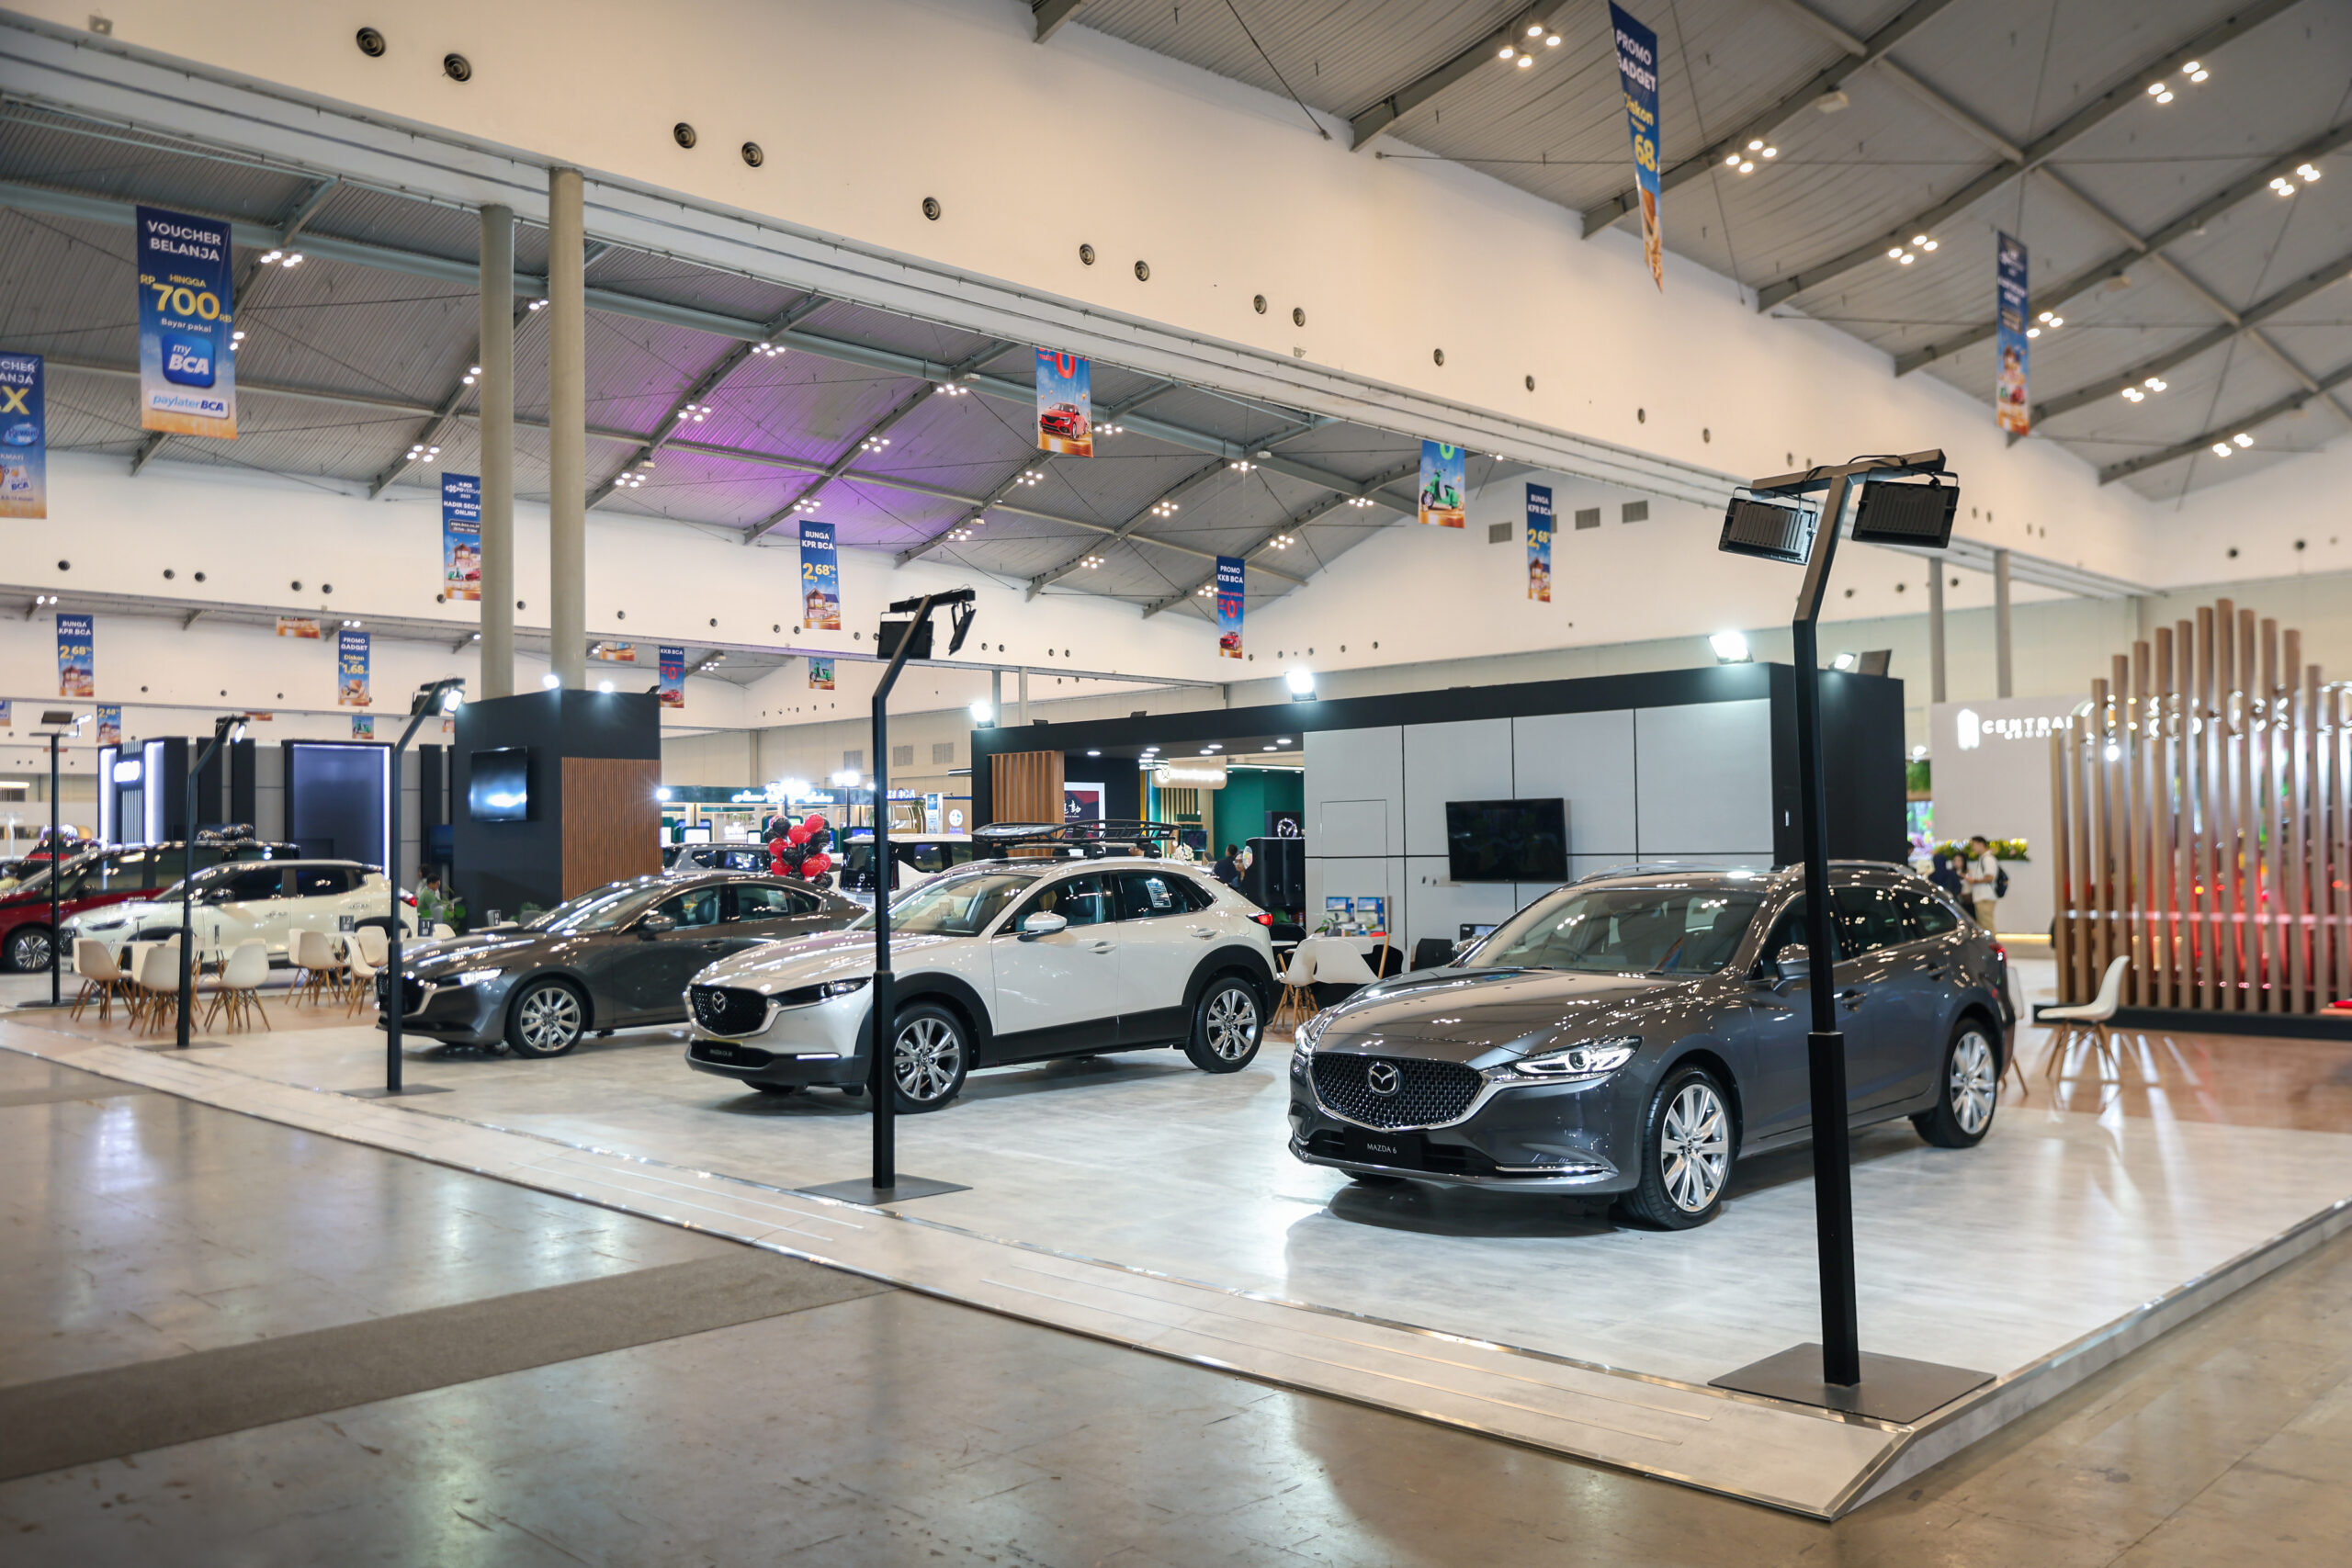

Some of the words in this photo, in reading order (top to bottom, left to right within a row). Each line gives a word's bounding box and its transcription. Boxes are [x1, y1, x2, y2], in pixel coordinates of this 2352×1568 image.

[1616, 29, 1652, 66] PROMO
[147, 220, 221, 246] VOUCHER
[150, 237, 220, 262] BELANJA
[169, 274, 207, 288] HINGGA
[140, 274, 156, 285] RP
[152, 283, 220, 320] 700
[219, 313, 232, 323] RB
[161, 317, 187, 330] Bayar
[187, 321, 212, 333] pakai
[172, 344, 192, 356] my
[168, 354, 209, 376] BCA
[153, 395, 224, 412] paylaterBCA
[1531, 494, 1549, 504] BUNGA
[1528, 503, 1540, 513] KPR
[805, 531, 830, 540] BUNGA
[801, 540, 817, 548] KPR
[818, 542, 834, 550] BCA
[1220, 565, 1240, 574] PROMO
[1366, 1143, 1392, 1153] MAZDA
[1392, 1146, 1397, 1155] 6
